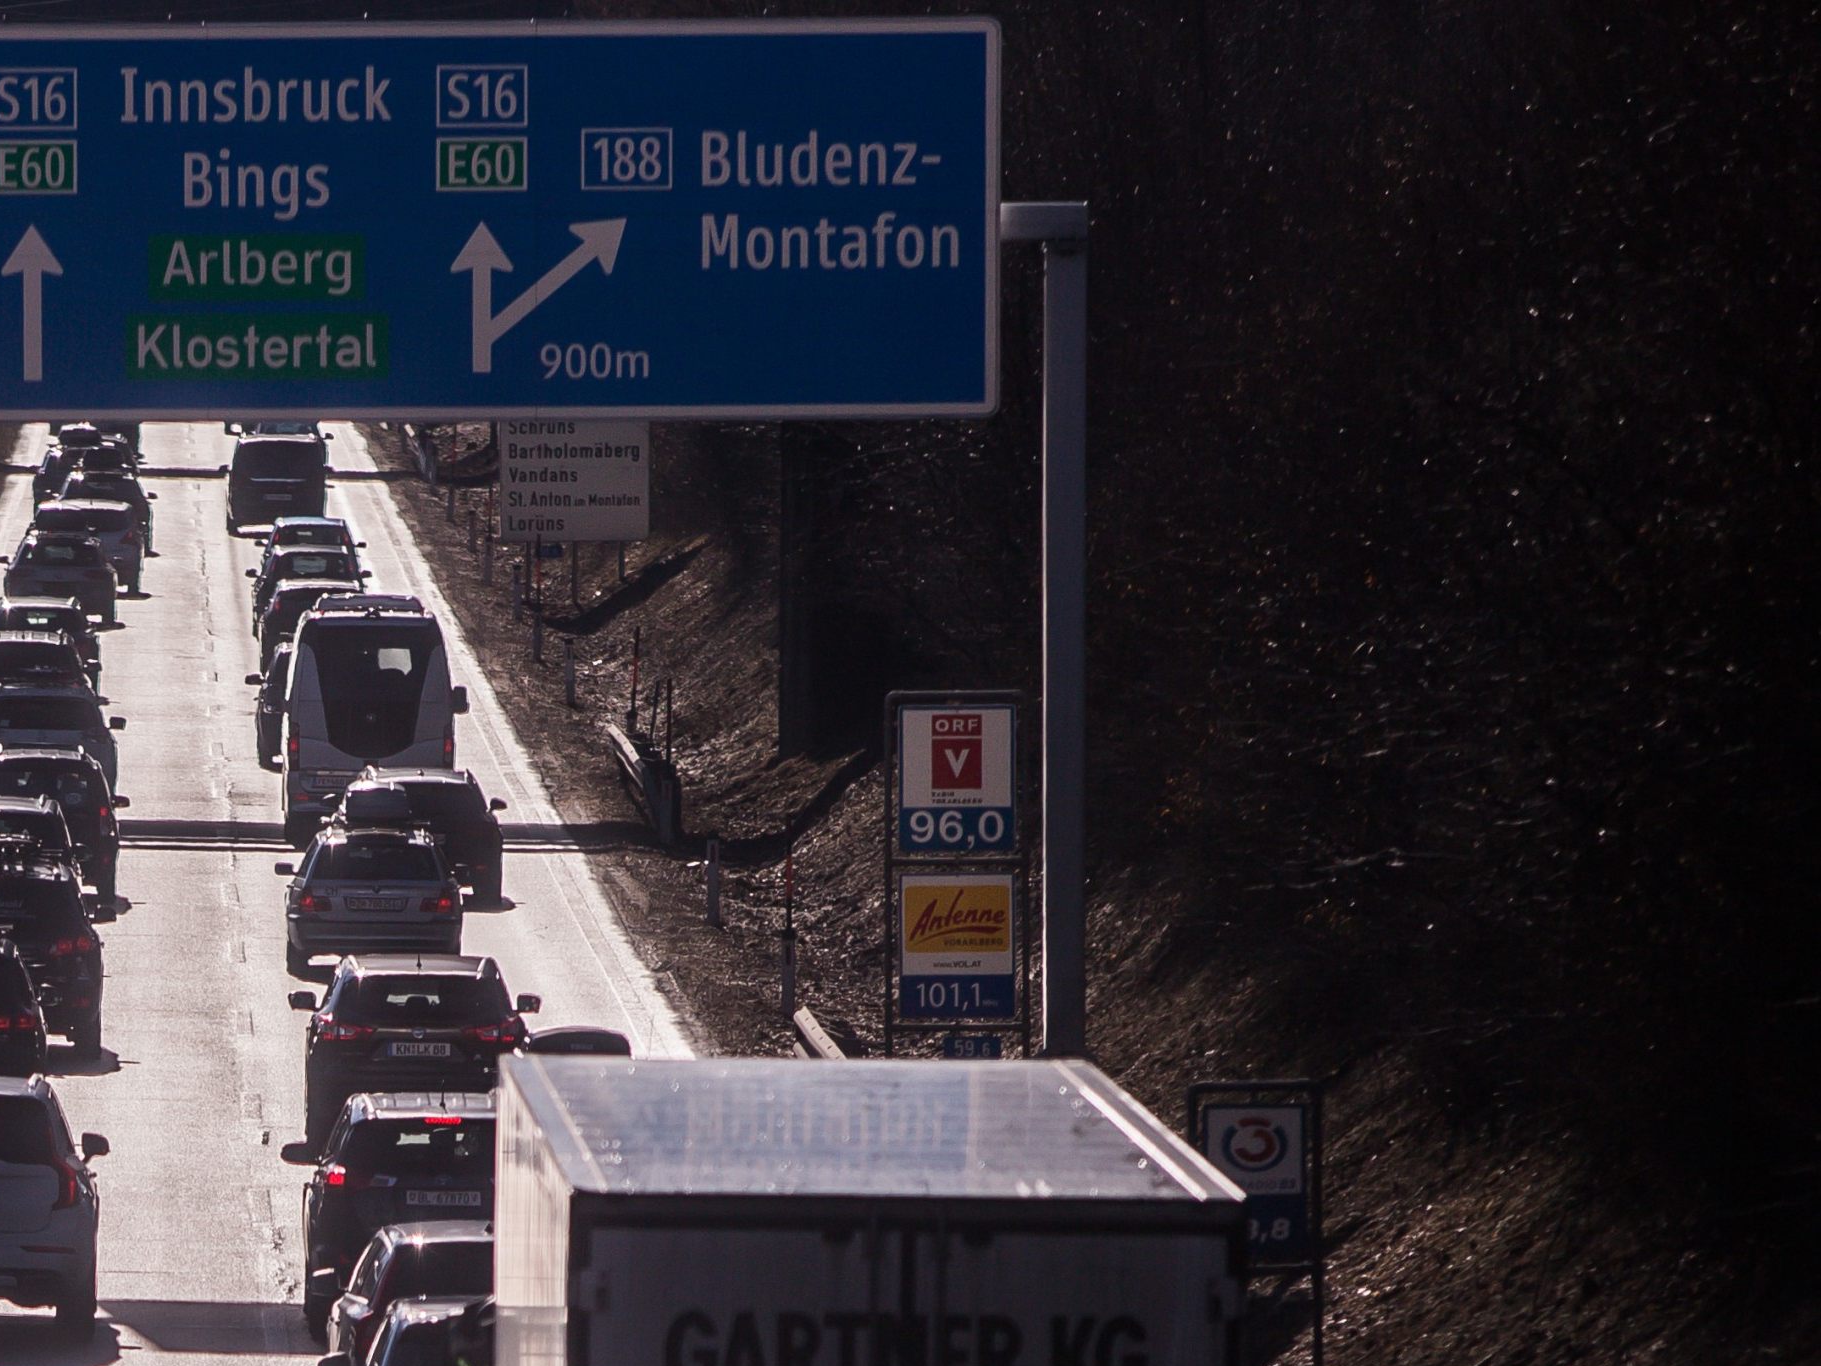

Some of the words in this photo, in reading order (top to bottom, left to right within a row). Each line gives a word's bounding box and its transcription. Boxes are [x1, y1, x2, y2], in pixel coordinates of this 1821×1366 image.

[120, 66, 391, 123] Innsbruck
[446, 74, 517, 120] S16
[447, 143, 516, 186] E60
[592, 137, 662, 182] 188
[700, 130, 941, 186] Bludenz-
[183, 149, 330, 220] Bings
[700, 212, 960, 269] Montafon
[163, 240, 352, 295] Arlberg
[137, 323, 376, 369] Klostertal
[540, 344, 649, 379] 900m
[508, 421, 576, 435] Schruns
[508, 442, 641, 462] Bartholomäberg
[508, 467, 578, 483] Vandans
[508, 491, 527, 507] St.
[530, 491, 571, 506] Anton
[588, 494, 640, 506] Montafon
[508, 515, 565, 531] Lorüns
[934, 719, 979, 732] ORF
[944, 748, 971, 779] V
[909, 810, 1005, 850] 96,0
[909, 889, 1006, 942] Antenne
[916, 982, 981, 1011] 101,1
